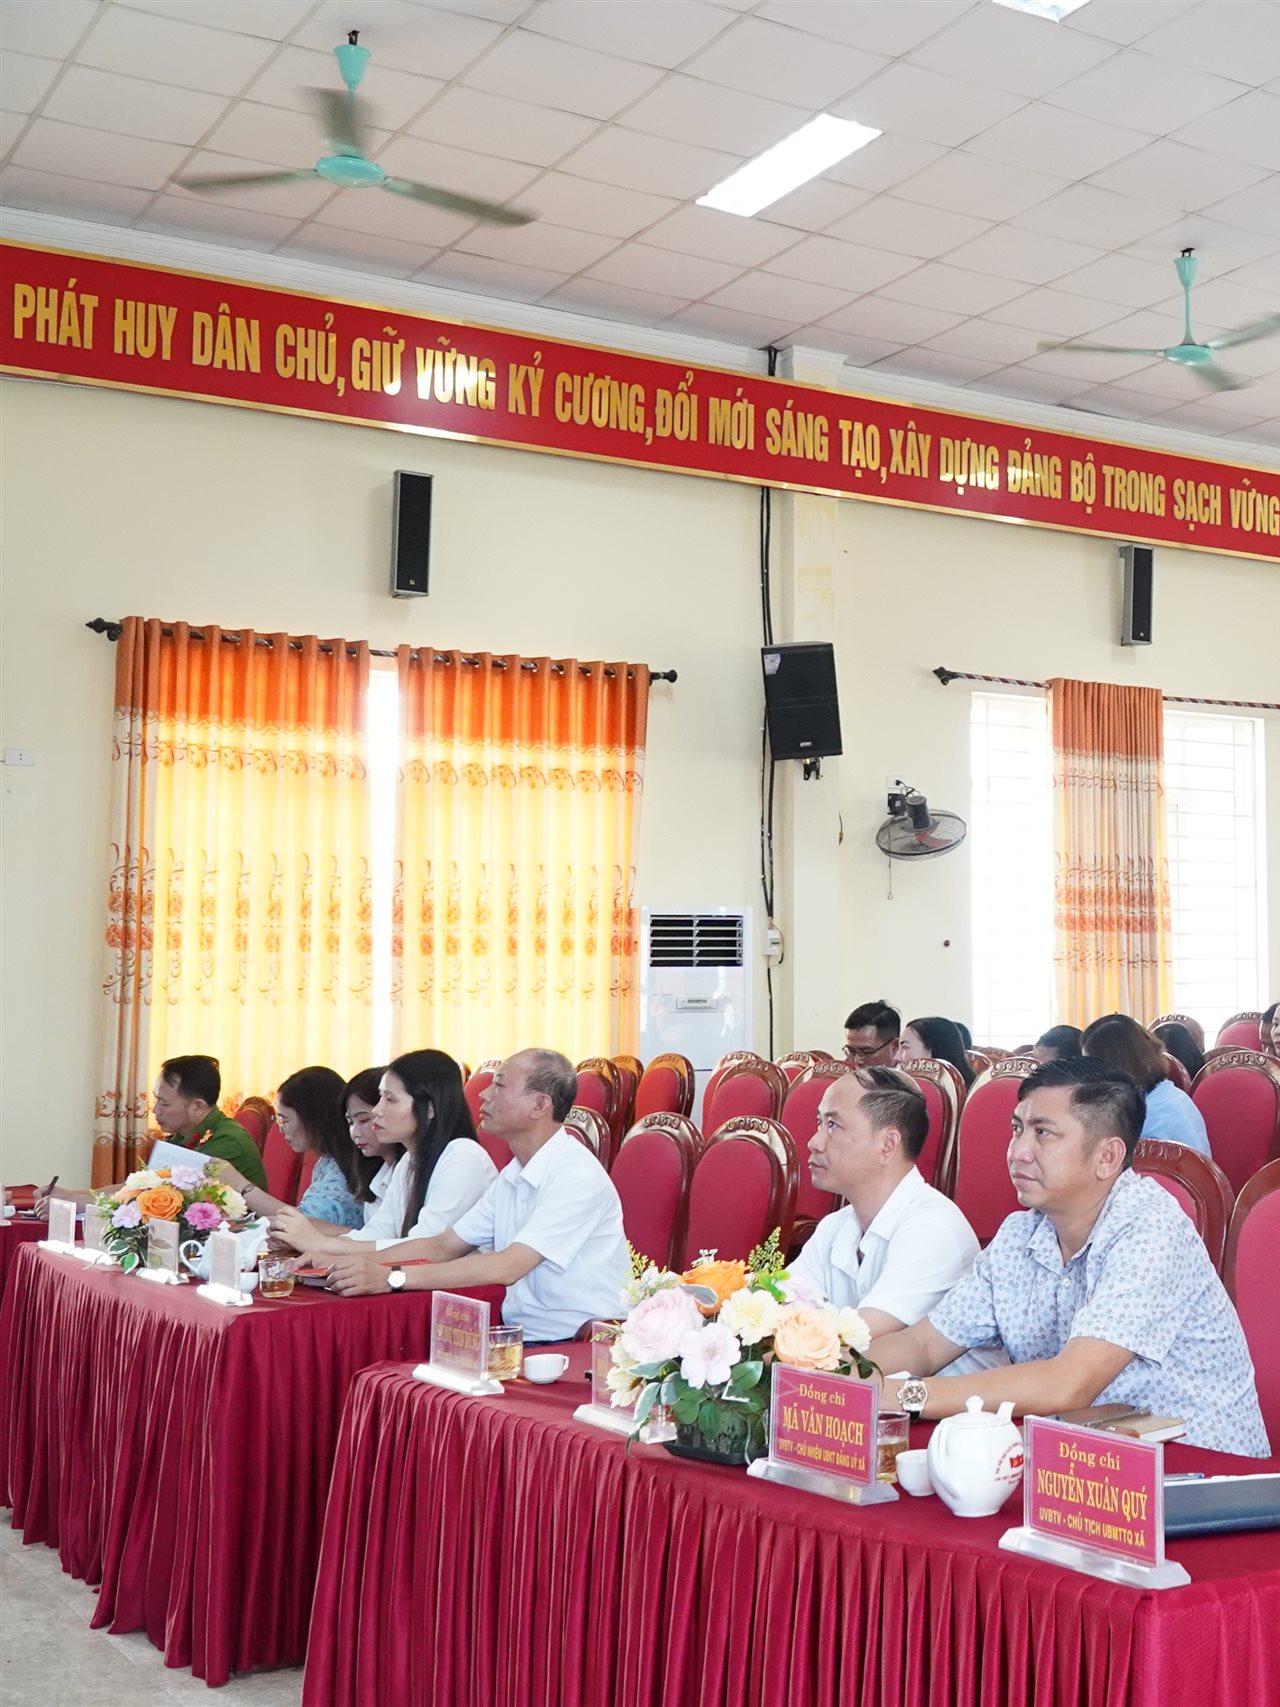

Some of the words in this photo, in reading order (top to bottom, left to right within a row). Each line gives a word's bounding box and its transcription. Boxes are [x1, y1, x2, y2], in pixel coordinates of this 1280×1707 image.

[14, 278, 99, 350] PHÁT
[114, 298, 178, 360] HUY
[192, 303, 261, 373] DÂN
[416, 336, 497, 411] VỮNG
[508, 351, 545, 417] KỶ
[708, 387, 755, 451] MỚI
[766, 399, 829, 462] SÁNG
[940, 436, 1000, 495] DỰNG
[1007, 437, 1062, 500] ĐẢNG
[1070, 452, 1097, 514] BỘ
[1101, 464, 1166, 518] TRONG
[1173, 478, 1222, 532] SẠCH
[1229, 477, 1280, 537] VỮNG
[829, 1391, 846, 1407] chí
[801, 1406, 823, 1436] VĂN
[825, 1415, 864, 1449] HOẠCH
[1059, 1441, 1096, 1468] Đồng
[1099, 1451, 1121, 1471] chí
[1037, 1461, 1085, 1505] NGUYỄN
[1086, 1476, 1119, 1514] XUÂN
[1121, 1485, 1148, 1523] QUÝ
[1039, 1506, 1062, 1525] UVBTV
[1067, 1511, 1083, 1532] CHỦ
[1083, 1518, 1101, 1537] TỊCH
